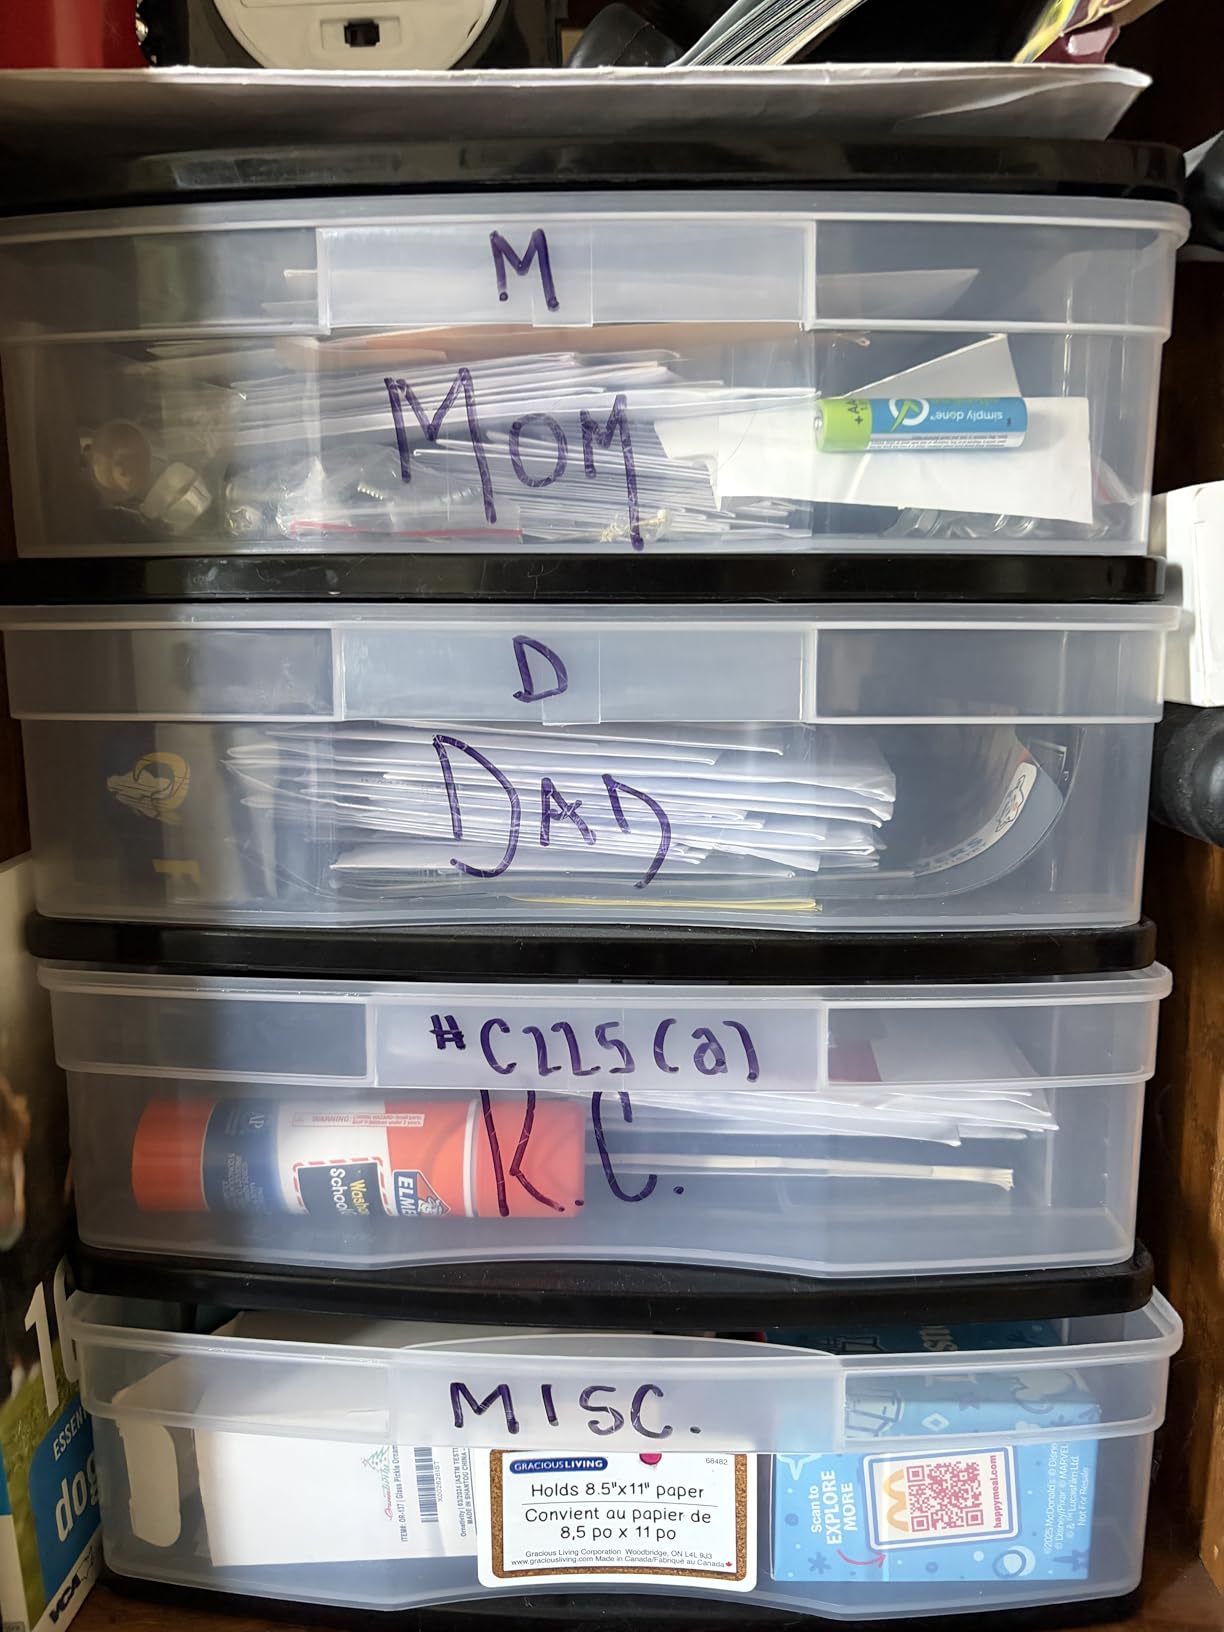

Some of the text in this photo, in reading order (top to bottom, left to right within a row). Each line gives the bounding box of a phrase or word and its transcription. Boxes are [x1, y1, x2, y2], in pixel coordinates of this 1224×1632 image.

[489, 228, 560, 312] M
[967, 409, 1003, 424] simply
[512, 634, 568, 703] D
[432, 734, 672, 889] DAD
[450, 1381, 702, 1440] MISC.
[460, 1452, 469, 1471] CHINA
[531, 1483, 579, 1497] Holds
[656, 1485, 704, 1500] paper
[821, 1469, 842, 1545] EXPLORE
[840, 1482, 858, 1531] MORE
[990, 1455, 1004, 1529] happymeal.com
[465, 1508, 473, 1524] MADE
[525, 1507, 711, 1523] Convient au papier de
[808, 1485, 823, 1533] Scan to
[560, 1526, 676, 1542] 8,5 po x 11 po
[511, 1556, 594, 1566] www.graciousliving.com
[697, 1559, 725, 1568] Canada
[525, 1550, 557, 1558] Gracious
[625, 1549, 669, 1558] Woodbridge,
